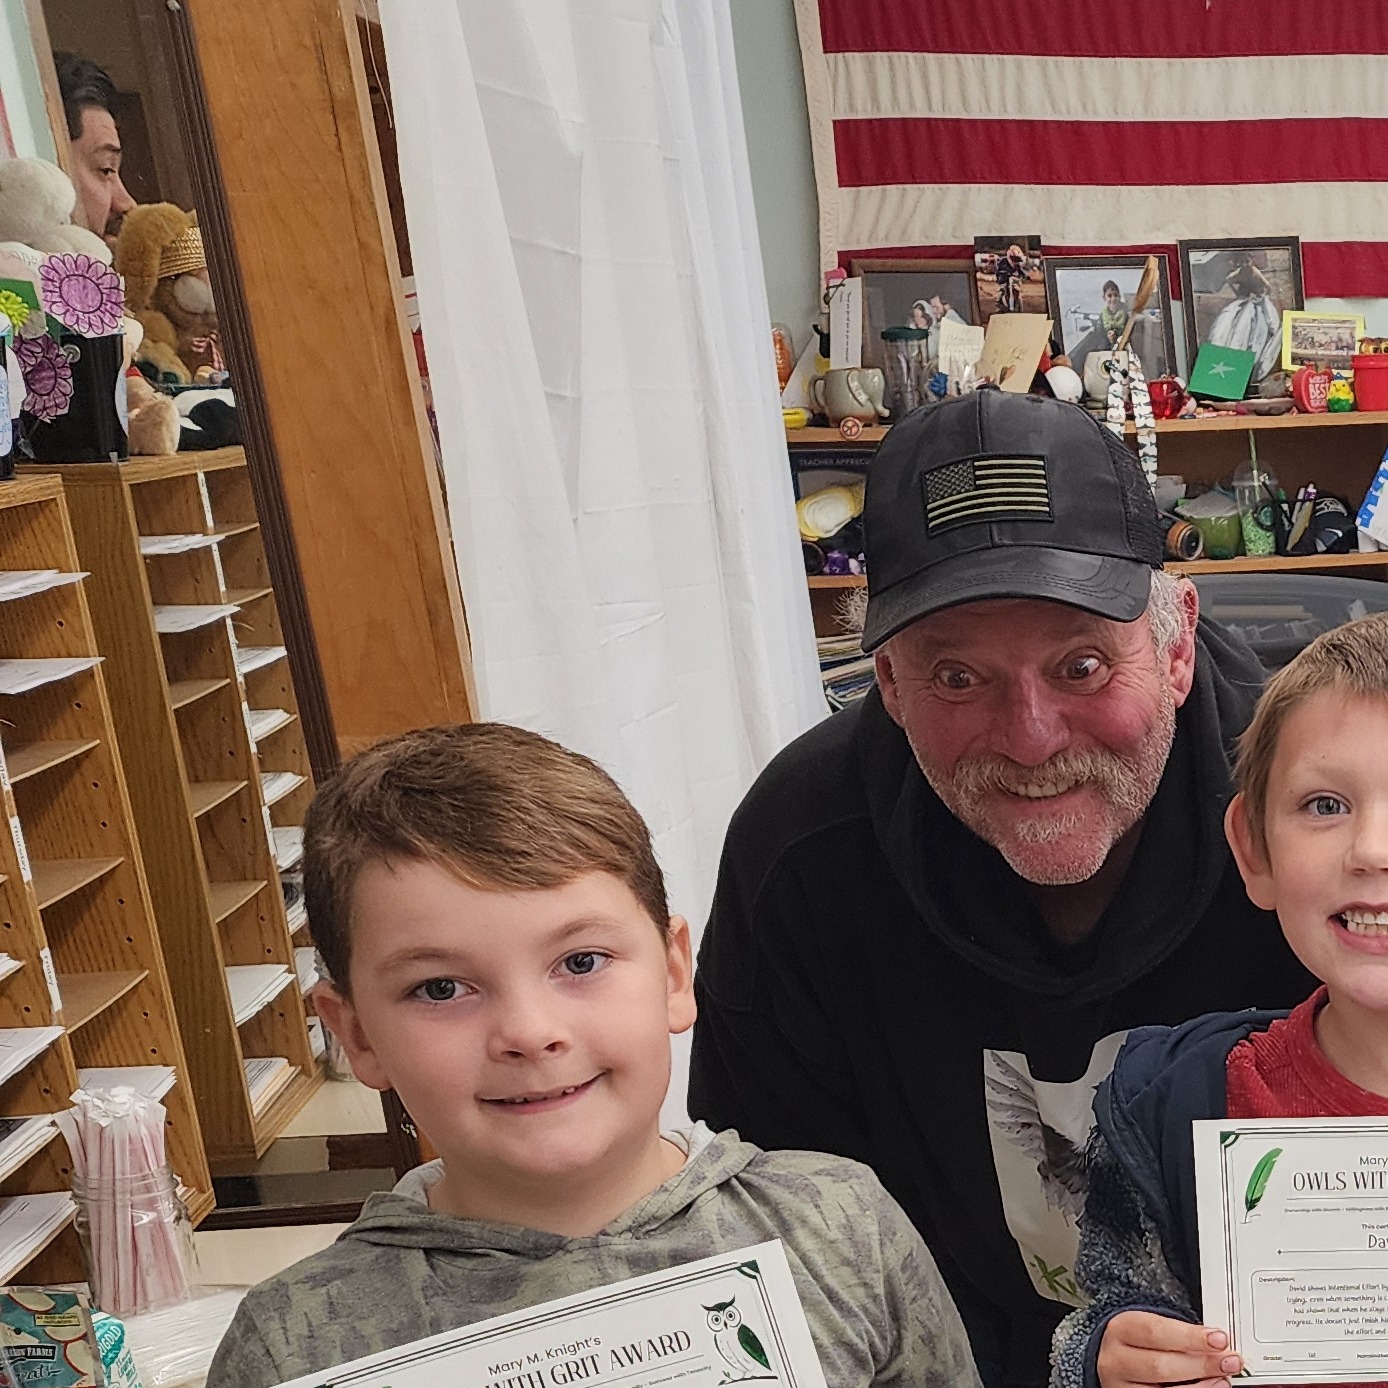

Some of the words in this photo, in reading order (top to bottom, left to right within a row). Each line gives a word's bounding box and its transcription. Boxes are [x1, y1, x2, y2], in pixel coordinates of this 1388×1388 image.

[1308, 383, 1330, 399] BEST
[1359, 1155, 1388, 1168] Mary
[1293, 1171, 1347, 1191] OWLS
[487, 1358, 523, 1376] Mary
[526, 1352, 544, 1365] M.
[544, 1336, 601, 1360] Knight's
[550, 1353, 600, 1385] GRIT
[610, 1330, 691, 1371] AWARD
